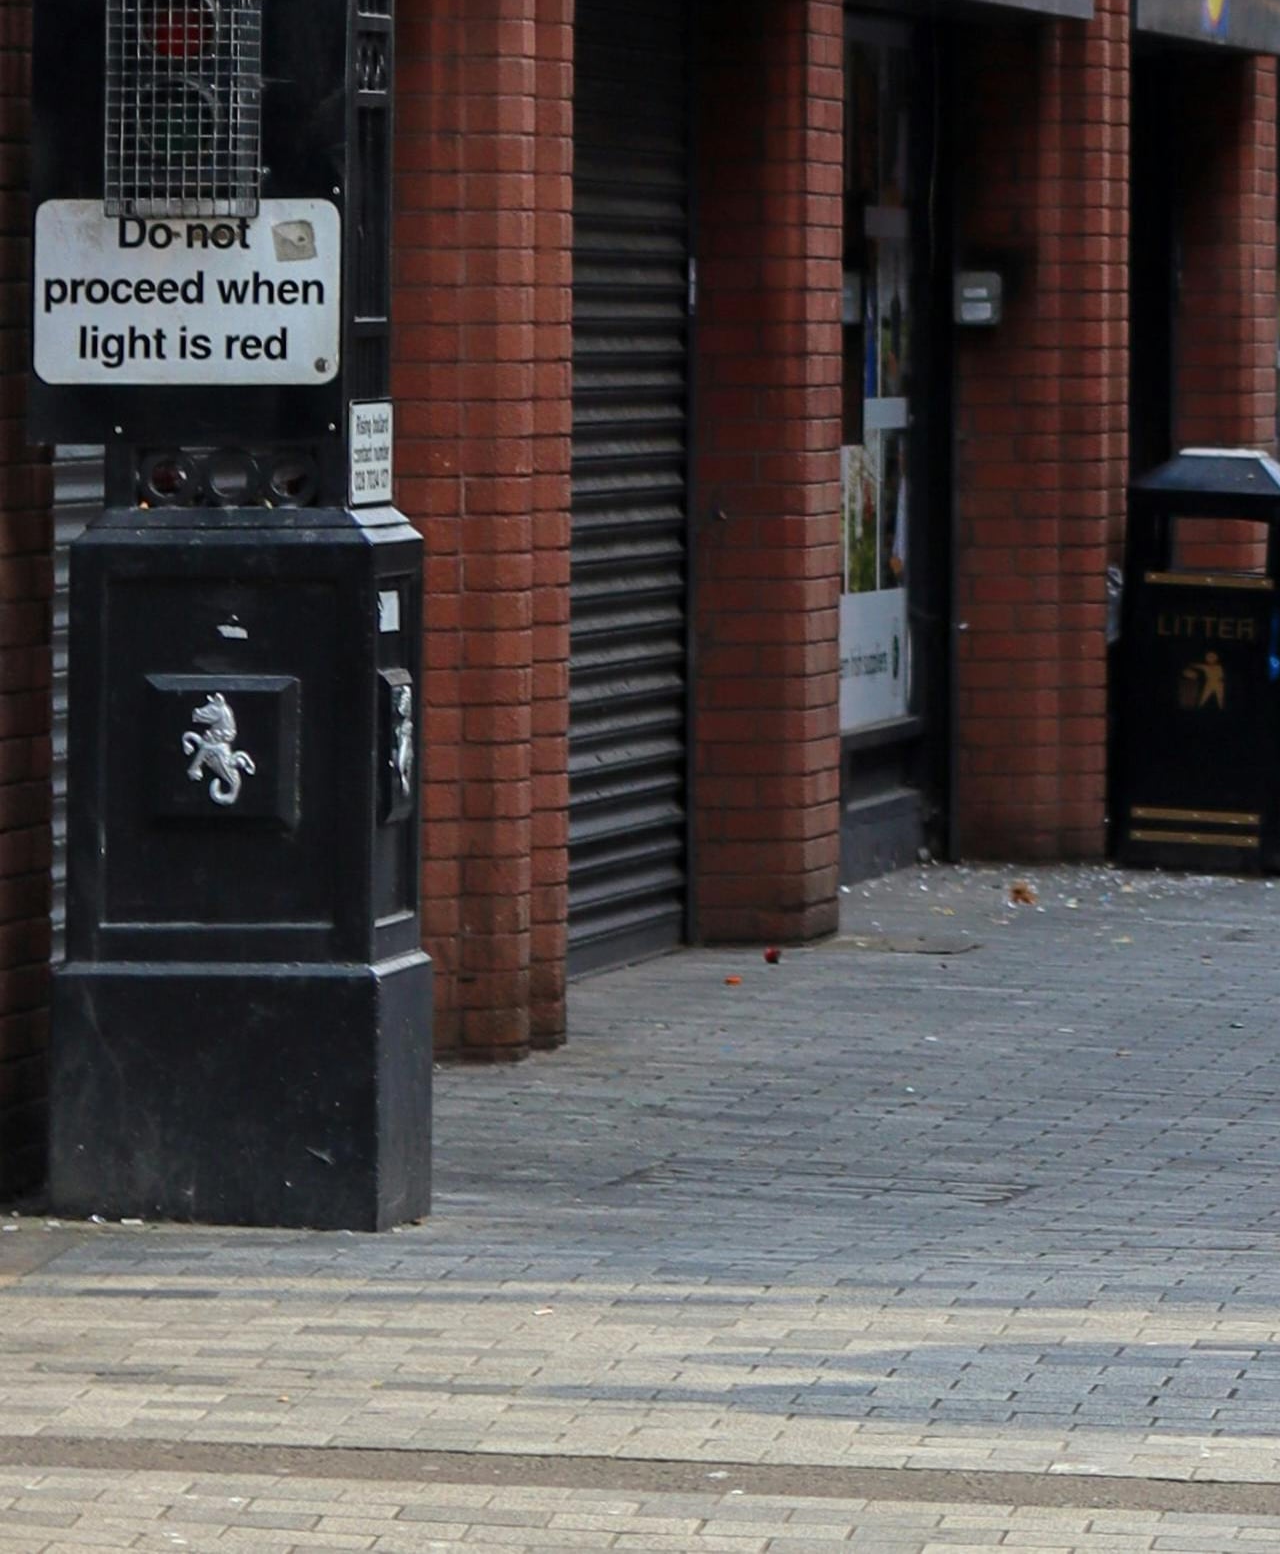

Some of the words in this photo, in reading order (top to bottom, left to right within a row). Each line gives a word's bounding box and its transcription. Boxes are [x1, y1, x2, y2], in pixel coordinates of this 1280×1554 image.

[118, 217, 172, 249] Do
[186, 218, 251, 250] not
[44, 270, 204, 313] proceed
[216, 271, 324, 305] when
[79, 325, 167, 369] light
[179, 326, 212, 360] is
[225, 327, 287, 361] red
[1157, 614, 1256, 641] LITTER
